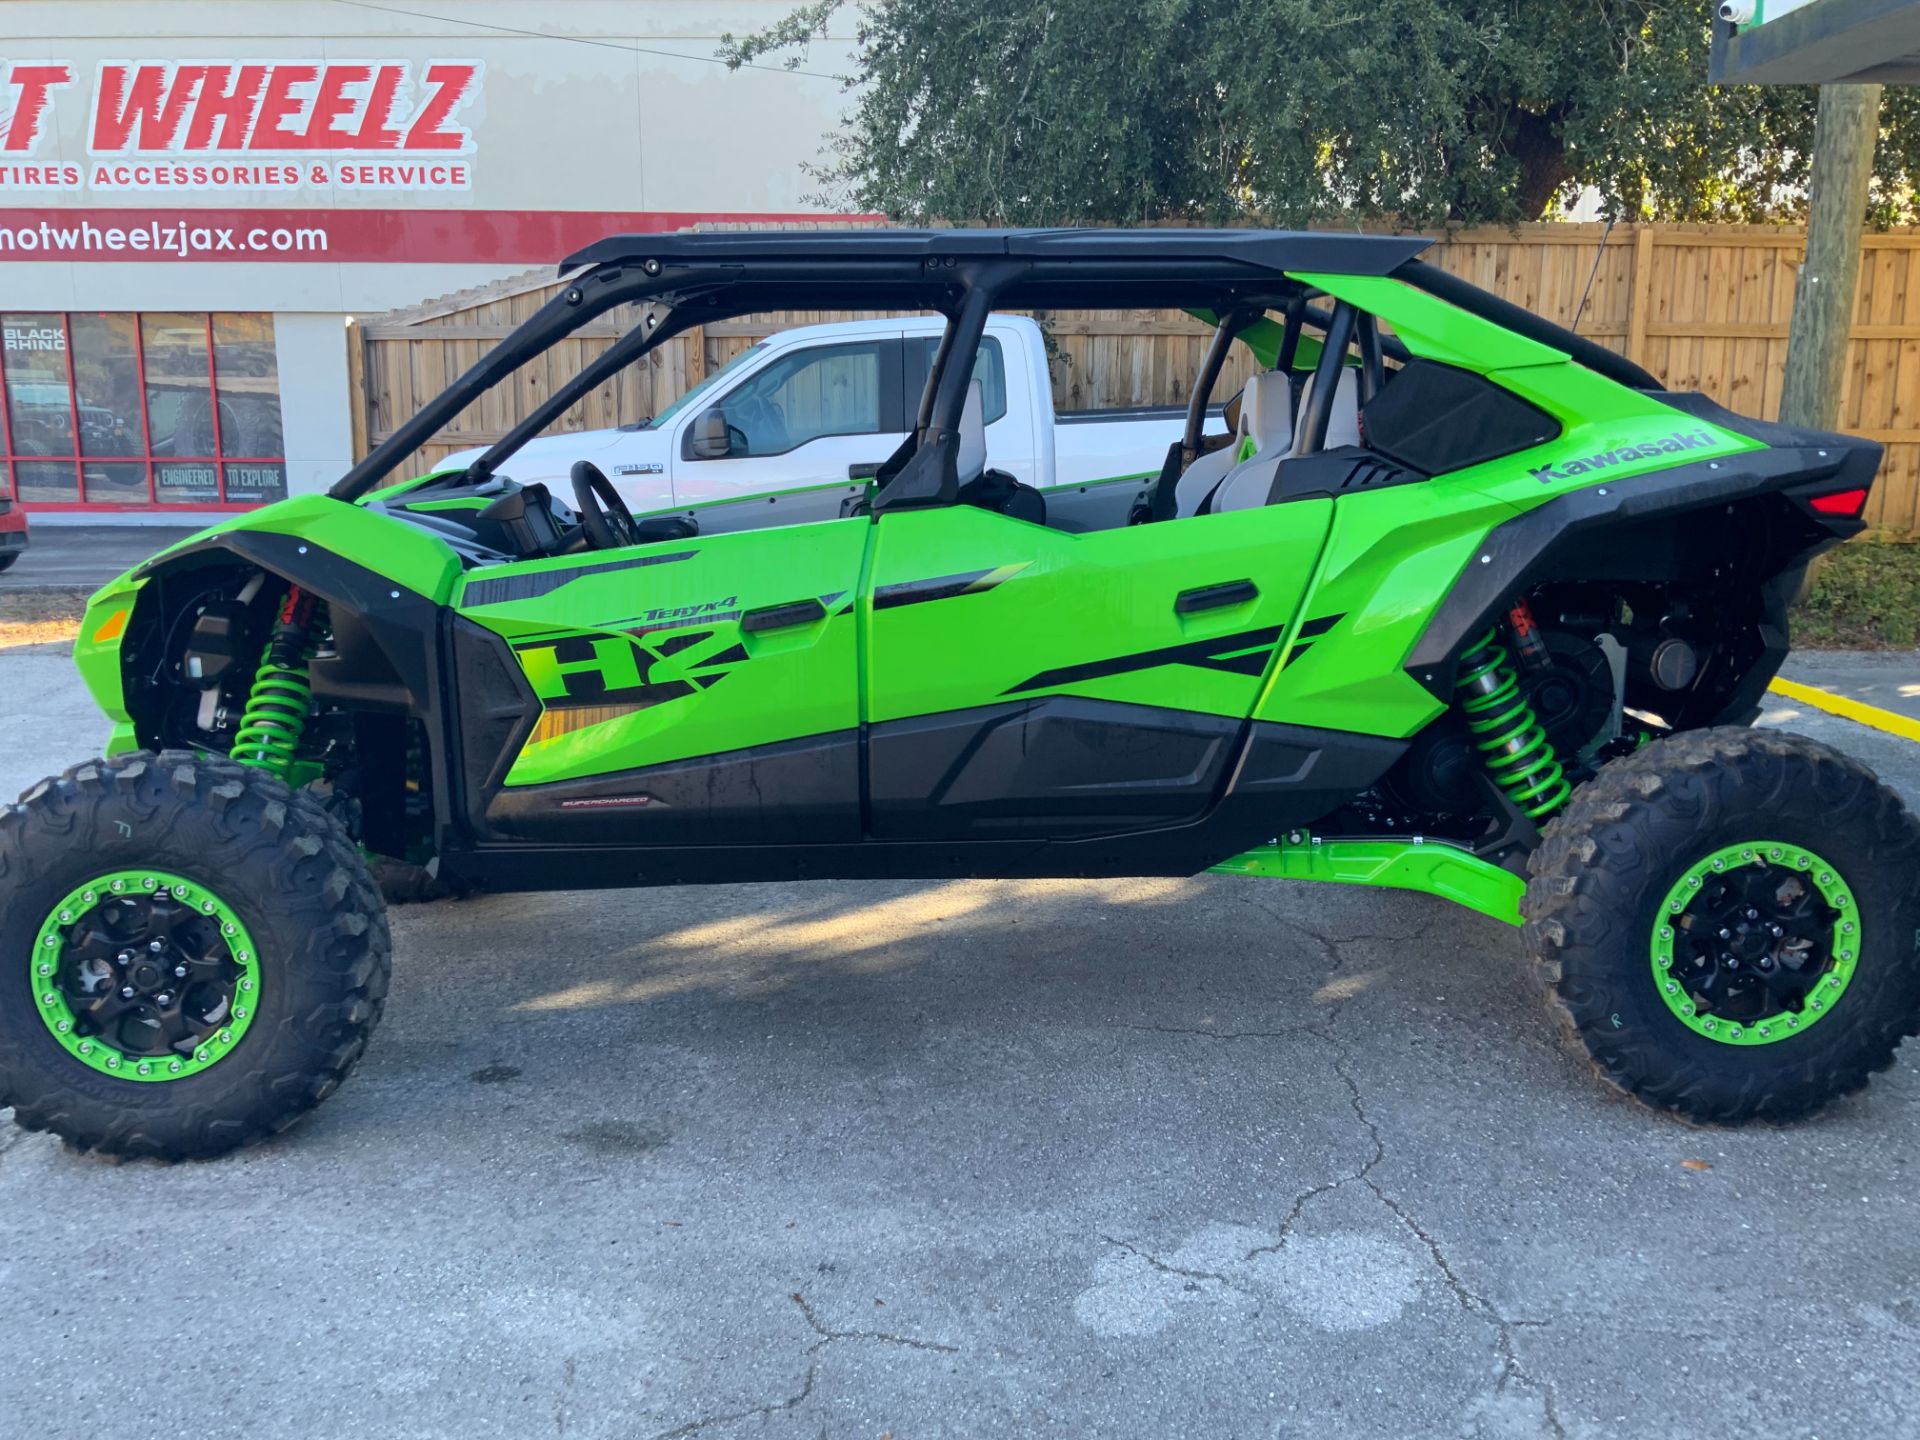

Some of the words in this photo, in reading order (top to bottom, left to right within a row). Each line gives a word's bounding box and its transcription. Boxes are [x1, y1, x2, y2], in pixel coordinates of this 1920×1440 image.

[91, 64, 476, 151] WHEELZ
[0, 166, 79, 185] TIRES
[94, 166, 300, 185] ACCESSORIES
[310, 168, 329, 184] &
[339, 166, 467, 185] SERVICE
[4, 328, 65, 340] BLACK
[1527, 428, 1717, 484] Kawasaki
[161, 468, 215, 486] ENGINEERED
[226, 469, 239, 486] TO
[240, 469, 281, 487] EXPLORE
[561, 796, 649, 807] SUPERCHARGED
